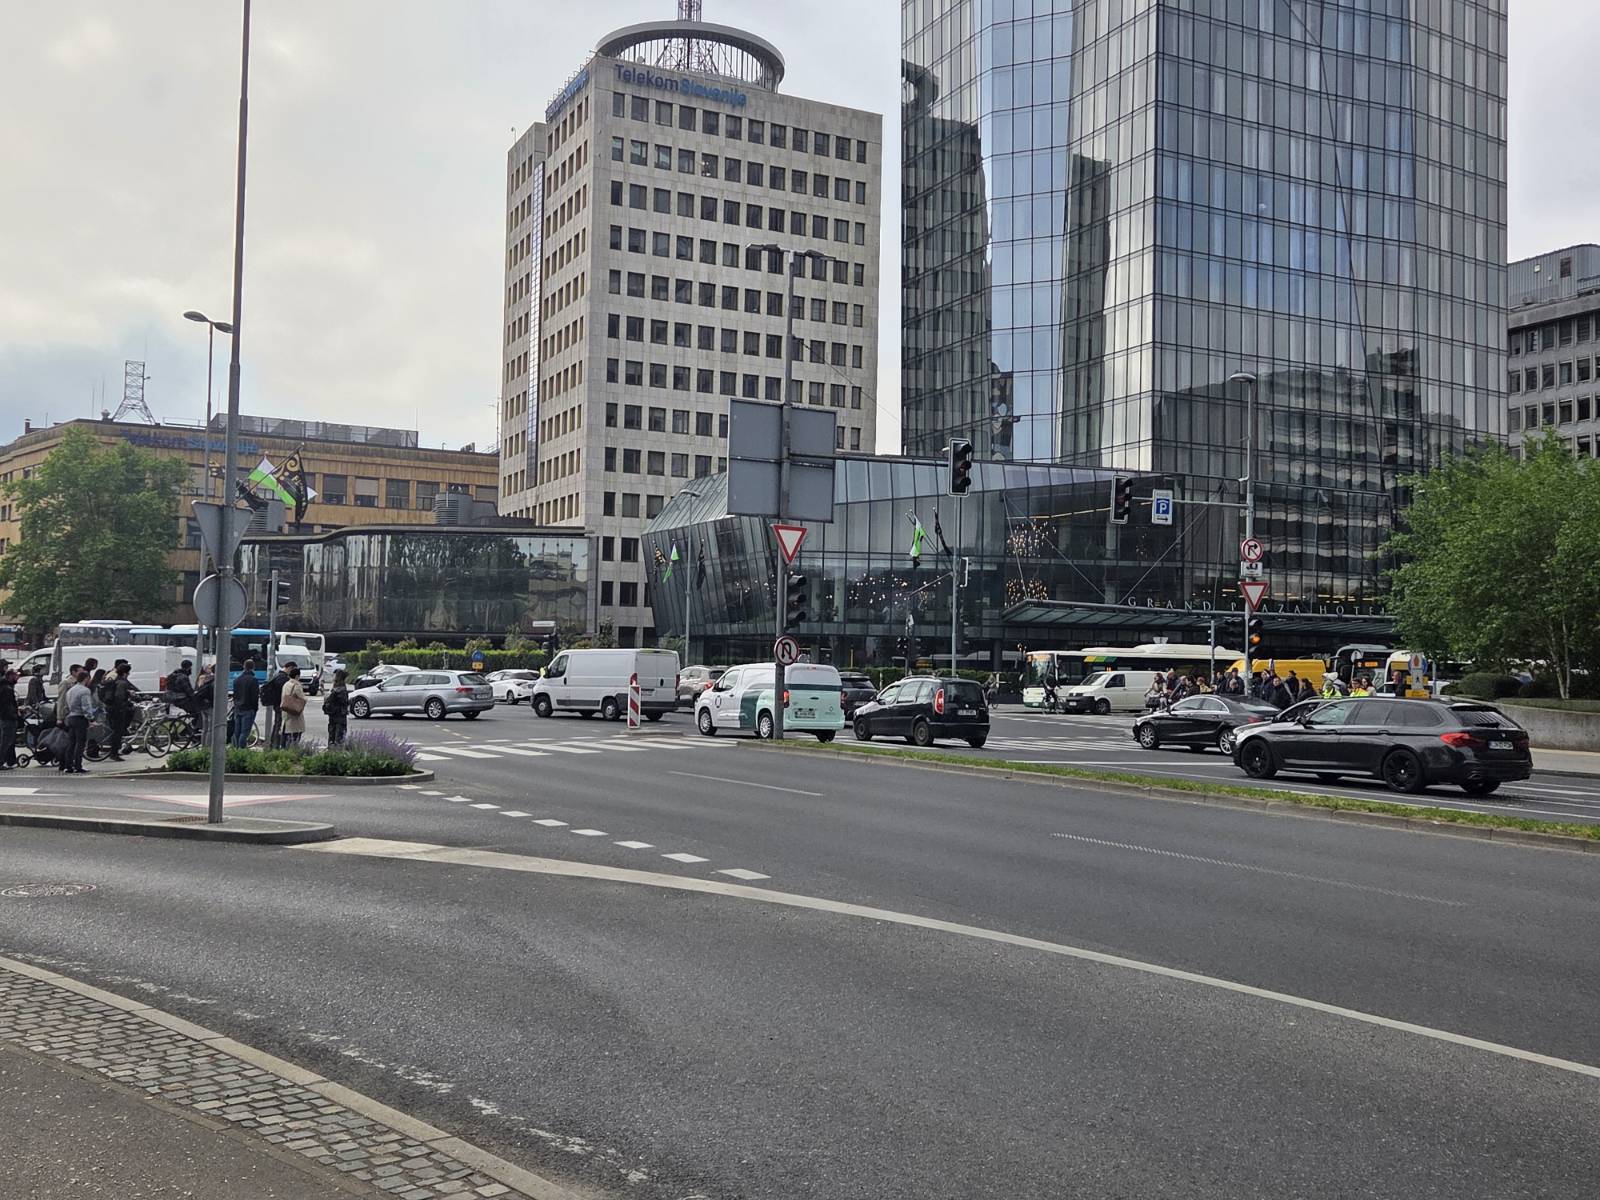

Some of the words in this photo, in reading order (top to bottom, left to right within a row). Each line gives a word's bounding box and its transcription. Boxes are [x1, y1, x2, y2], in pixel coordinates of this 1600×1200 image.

[614, 63, 679, 92] Telekom
[680, 78, 747, 108] Slovenije
[1159, 502, 1168, 514] P
[1127, 596, 1212, 611] GRAND
[1230, 602, 1301, 615] PAZA
